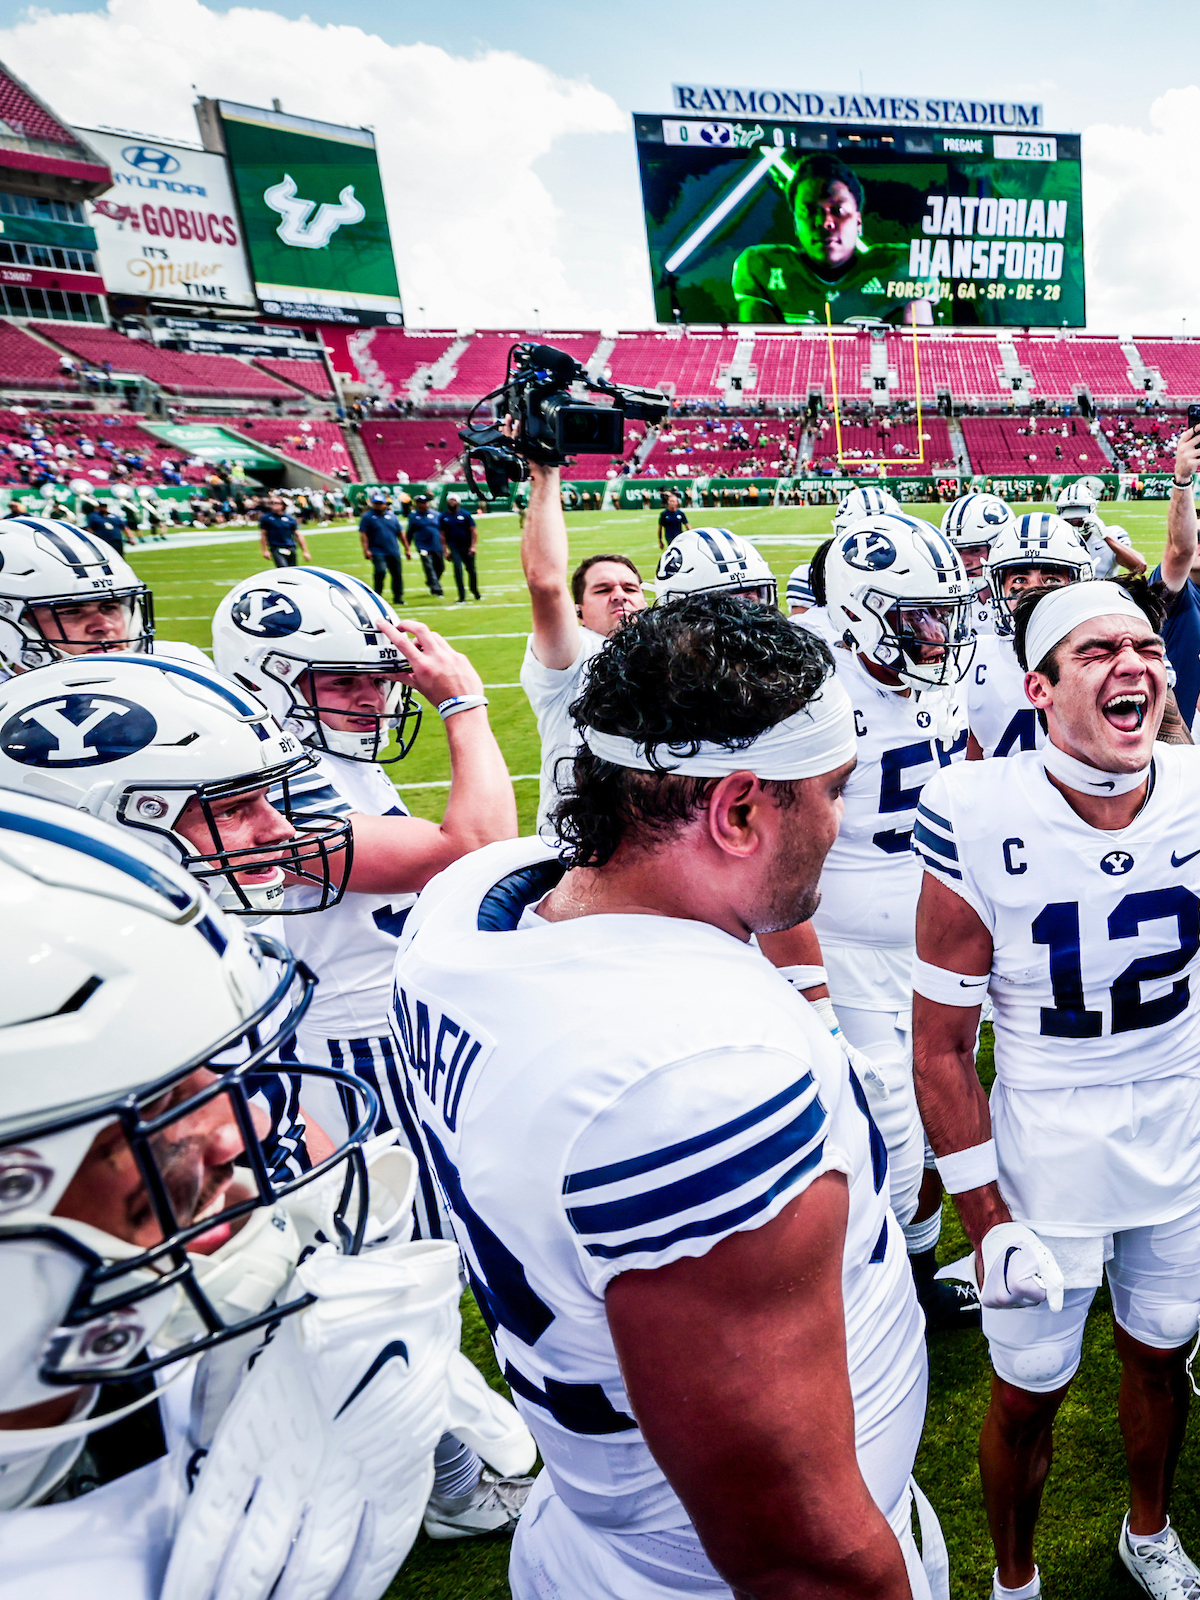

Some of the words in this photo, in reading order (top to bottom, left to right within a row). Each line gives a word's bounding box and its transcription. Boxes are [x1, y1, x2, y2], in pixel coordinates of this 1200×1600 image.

[676, 86, 824, 115] RAYMOND
[829, 94, 919, 120] JAMES
[925, 99, 1039, 126] STADIUM
[679, 125, 689, 142] 0
[943, 137, 984, 154] PREGAME
[1016, 141, 1052, 157] 22:31
[130, 203, 237, 247] #GOBUCS
[922, 195, 1068, 239] JATORIAN
[142, 246, 169, 260] IT'S
[908, 239, 1065, 280] HANSFORD
[127, 258, 223, 291] Miller
[182, 281, 229, 300] TIME
[957, 283, 977, 300] GA
[986, 283, 1006, 300] SR
[1016, 285, 1034, 300] DE
[1043, 285, 1061, 301] 28
[1024, 549, 1040, 557] BYU
[92, 578, 113, 589] BYU
[729, 572, 746, 581] BYU
[948, 584, 962, 594] BYU
[379, 648, 398, 660] BYU
[975, 664, 987, 685] C
[19, 699, 131, 761] Y
[853, 709, 868, 737] C
[1002, 837, 1028, 875] C
[1031, 885, 1200, 1039] 12
